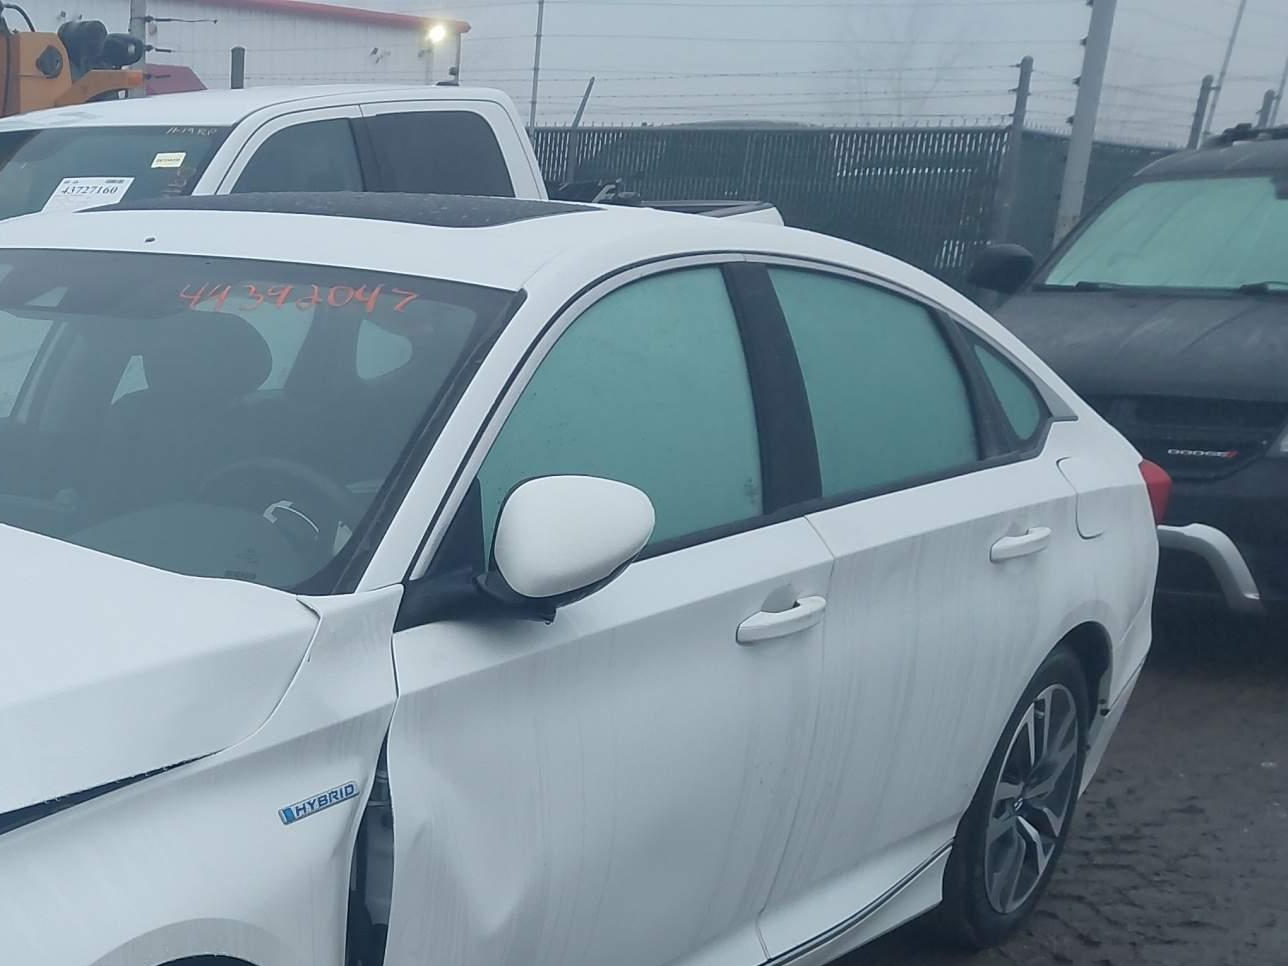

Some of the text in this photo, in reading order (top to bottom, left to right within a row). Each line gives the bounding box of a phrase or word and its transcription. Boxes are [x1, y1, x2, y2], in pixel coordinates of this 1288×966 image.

[61, 185, 119, 195] 43727160
[179, 283, 420, 312] 44392047
[1167, 448, 1226, 458] DODGE
[295, 783, 355, 817] HYBRID
